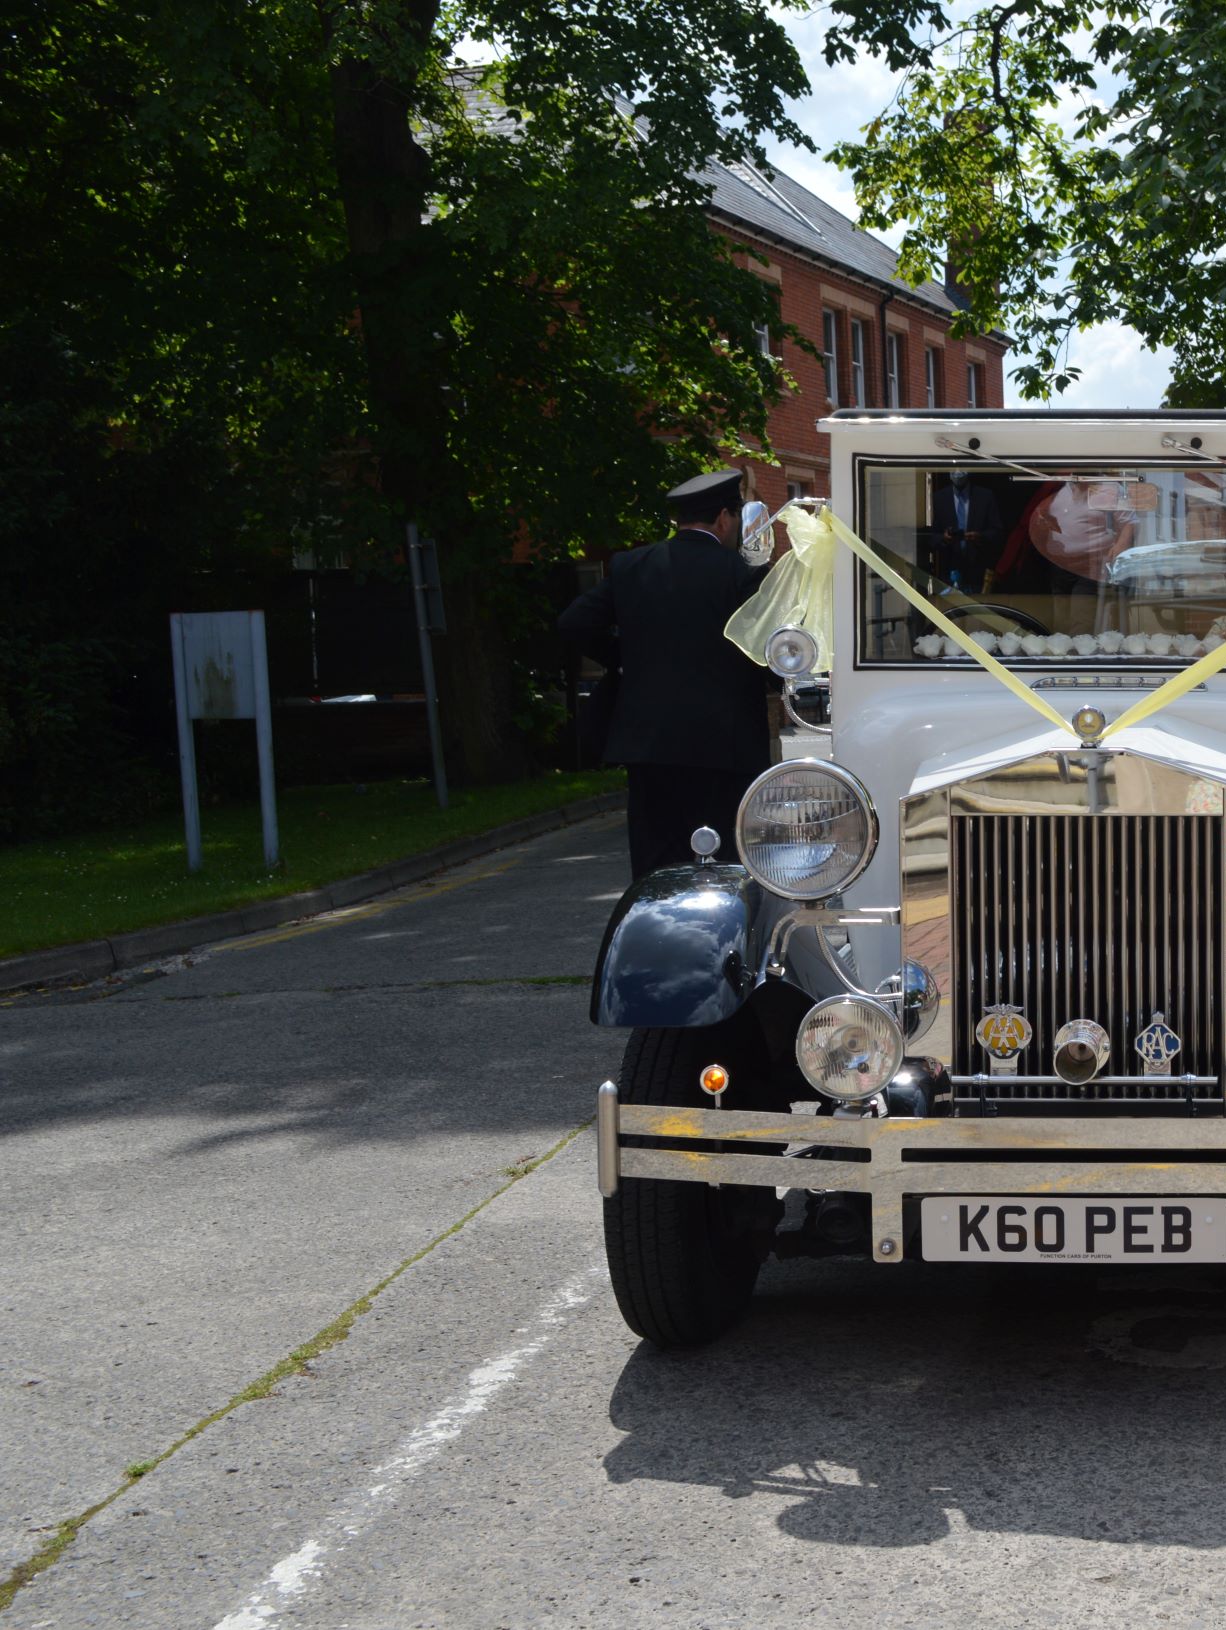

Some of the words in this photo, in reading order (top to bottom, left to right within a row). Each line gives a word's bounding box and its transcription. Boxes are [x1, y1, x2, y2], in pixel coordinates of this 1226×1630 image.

[988, 1014, 1022, 1049] AA
[1142, 1026, 1175, 1060] RAC
[959, 1205, 1065, 1252] K60
[1085, 1206, 1192, 1253] PEB
